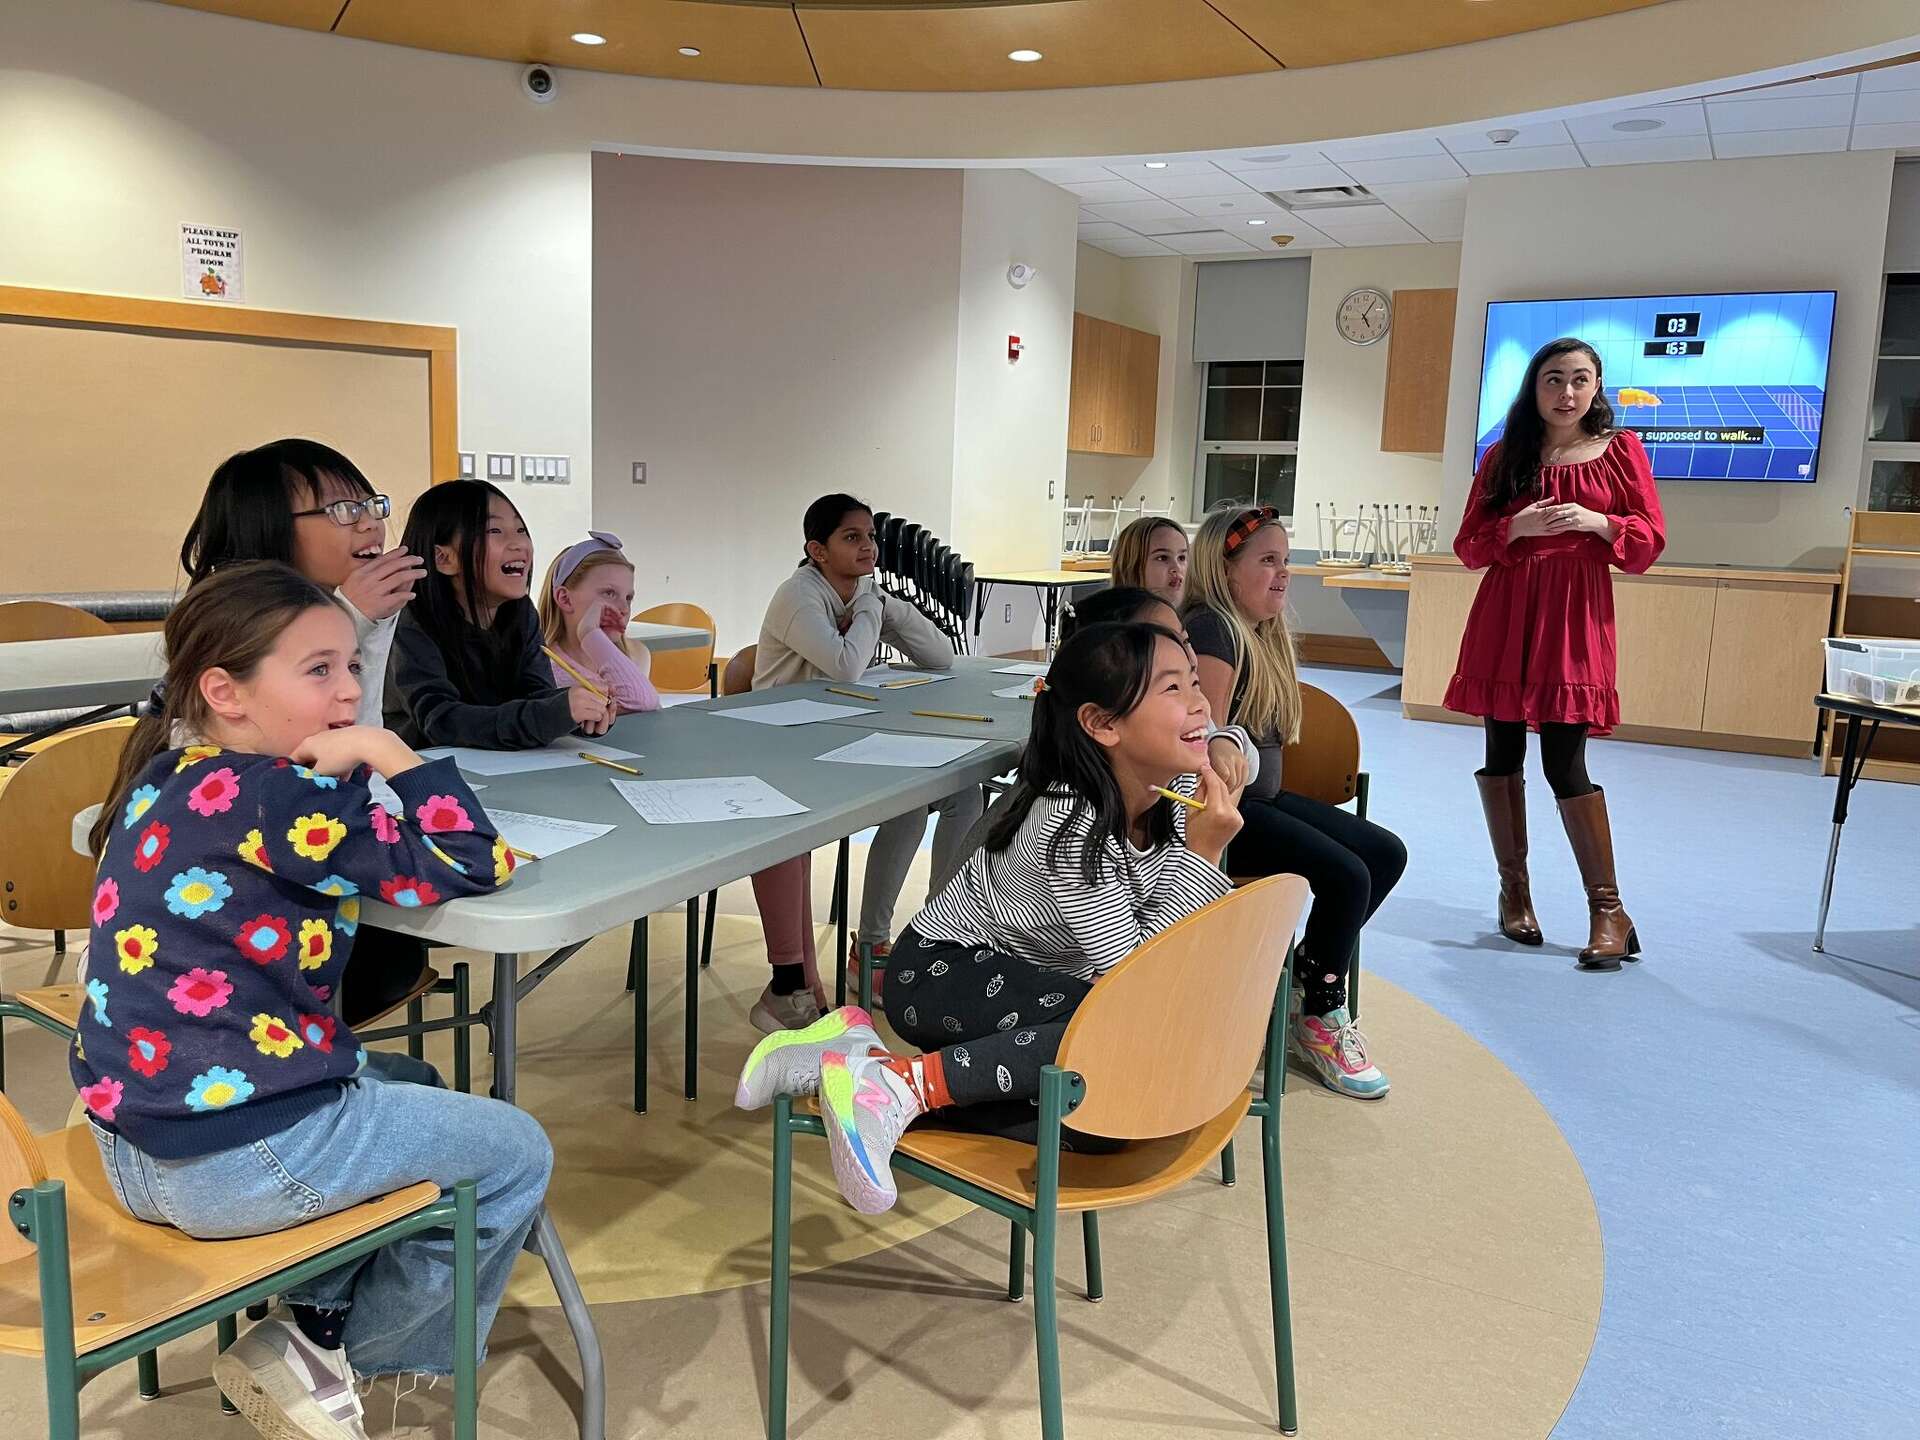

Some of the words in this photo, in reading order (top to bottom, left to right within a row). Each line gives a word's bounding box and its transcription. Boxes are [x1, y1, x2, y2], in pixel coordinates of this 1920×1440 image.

[183, 227, 215, 236] PLEASE
[216, 231, 239, 239] KEEP
[203, 239, 224, 247] TOYS
[191, 248, 232, 258] PROGRAM
[200, 258, 224, 266] ROOM
[1667, 318, 1687, 333] 03
[1665, 341, 1688, 355] 163
[1645, 430, 1702, 443] supposed
[1704, 430, 1718, 441] to
